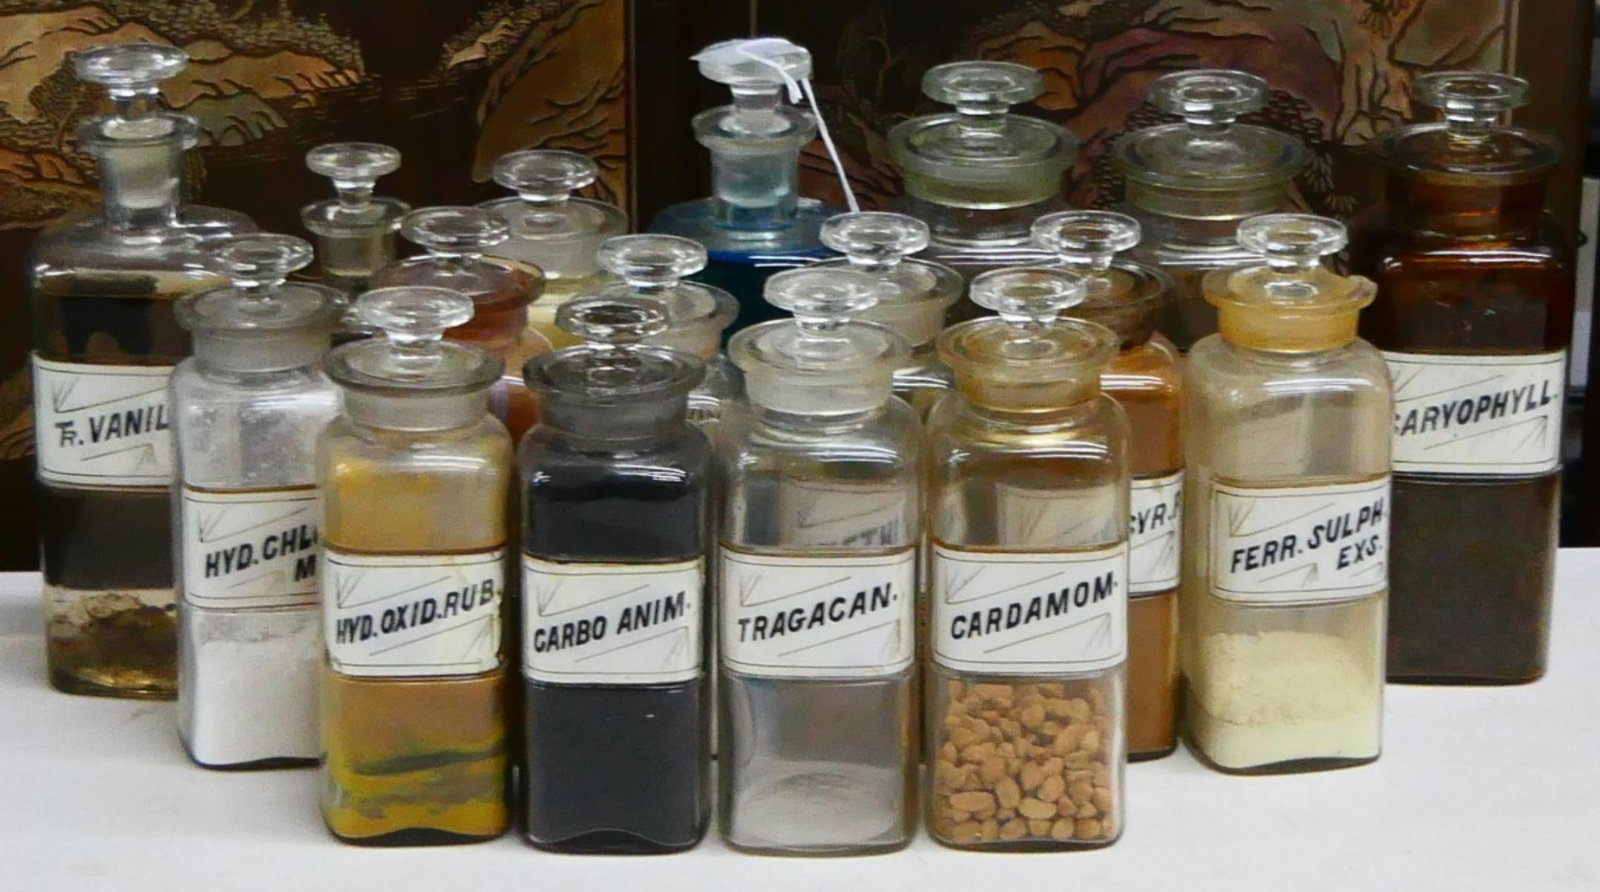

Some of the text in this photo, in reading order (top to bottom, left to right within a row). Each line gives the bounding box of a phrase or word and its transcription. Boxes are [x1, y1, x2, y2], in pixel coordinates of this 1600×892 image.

[533, 591, 691, 654] CARBO ANIM.
[738, 582, 897, 643] TRAGACAN.
[951, 571, 1118, 640] CARDAMOM.
